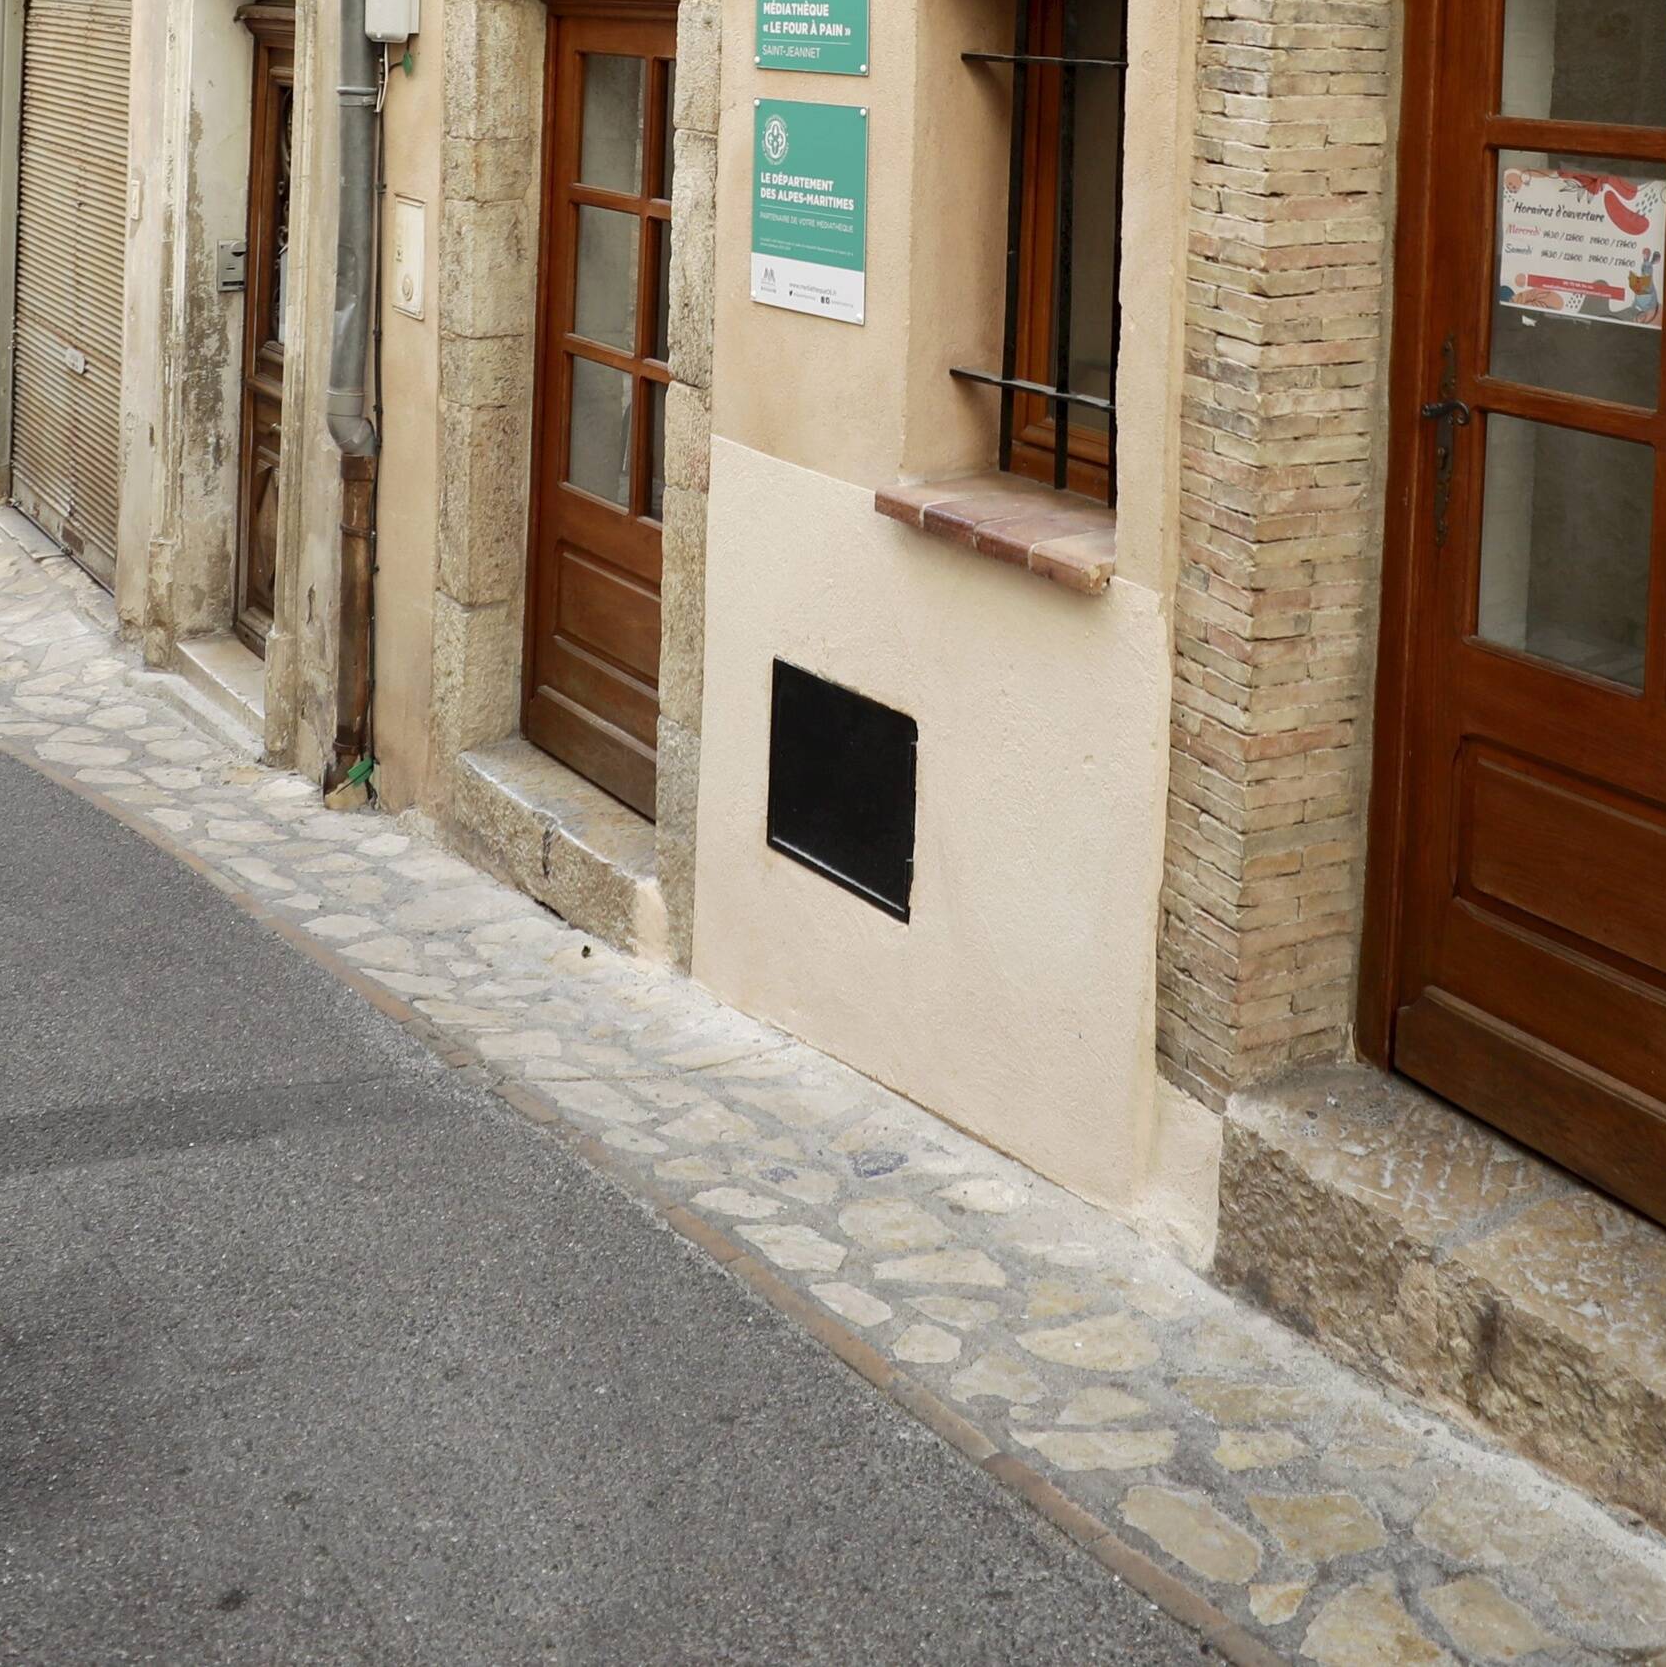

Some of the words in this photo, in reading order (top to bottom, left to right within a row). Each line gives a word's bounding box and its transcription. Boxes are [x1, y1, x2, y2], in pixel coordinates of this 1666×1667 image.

[763, 0, 829, 17] MÉDIATHÈQUE
[770, 21, 781, 34] LE
[782, 21, 808, 35] FOUR
[810, 19, 817, 36] À
[819, 23, 843, 37] PAIN
[762, 44, 821, 59] SAINT-JEANNET
[760, 171, 772, 184] LE
[772, 171, 834, 192] DÉPARTEMENT
[760, 187, 776, 200] DES
[777, 189, 854, 211] ALPES-MARITIMES
[1514, 202, 1554, 218] Horaires
[1555, 204, 1605, 223] d'ouverture
[799, 218, 815, 228] VOTRE
[1507, 224, 1541, 237] Mercredi
[1504, 242, 1533, 255] Samedi
